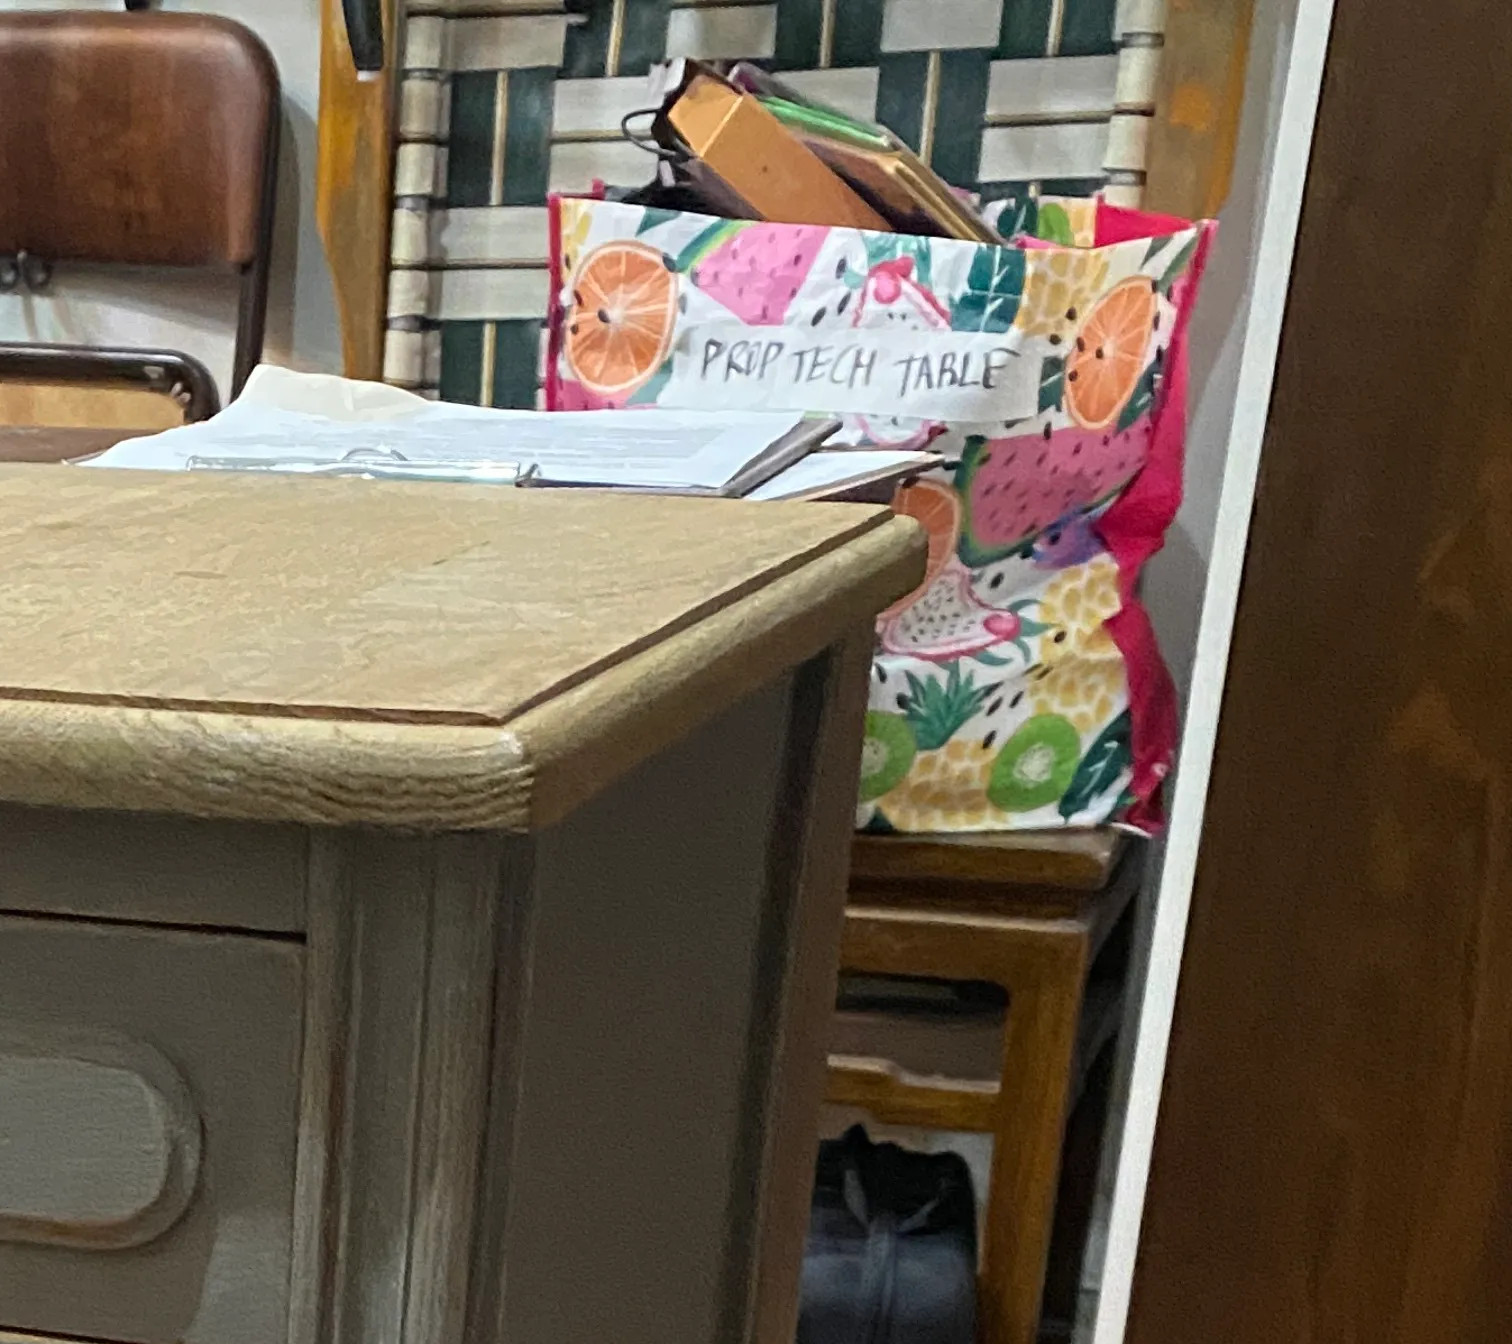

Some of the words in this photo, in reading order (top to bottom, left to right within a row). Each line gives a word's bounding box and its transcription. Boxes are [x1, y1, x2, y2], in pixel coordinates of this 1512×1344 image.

[700, 338, 785, 383] PROP
[792, 345, 879, 389] TECH
[893, 348, 1021, 397] TABLE
